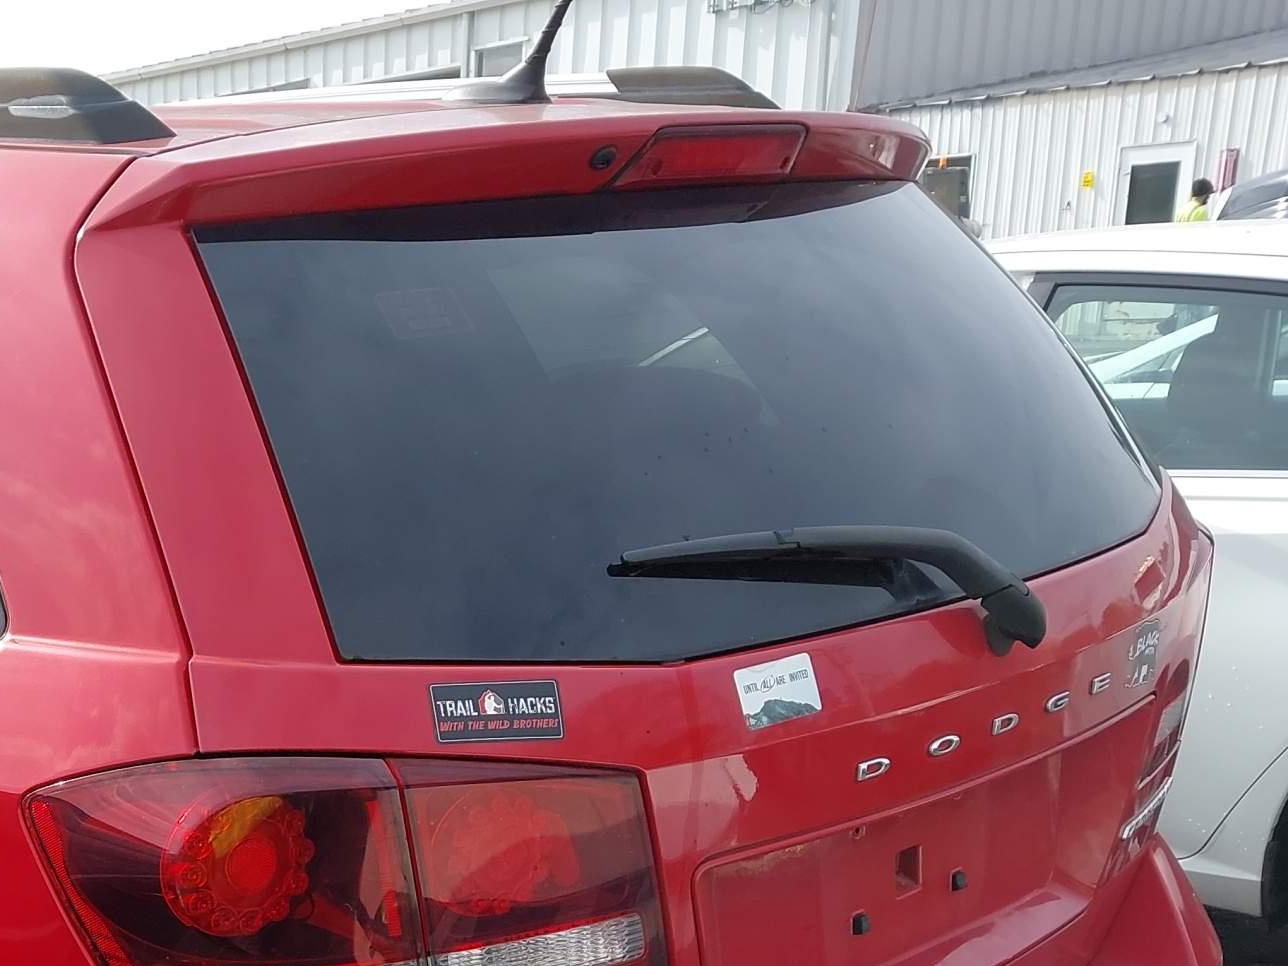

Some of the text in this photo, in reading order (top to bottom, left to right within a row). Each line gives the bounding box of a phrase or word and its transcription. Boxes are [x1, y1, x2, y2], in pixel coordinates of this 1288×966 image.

[743, 669, 809, 694] UNTIL ALL ARE INVITED
[437, 697, 556, 717] TRAIL HACKS
[440, 718, 558, 731] WITH THE WILD BROTHERS
[855, 672, 1113, 783] DODGE
